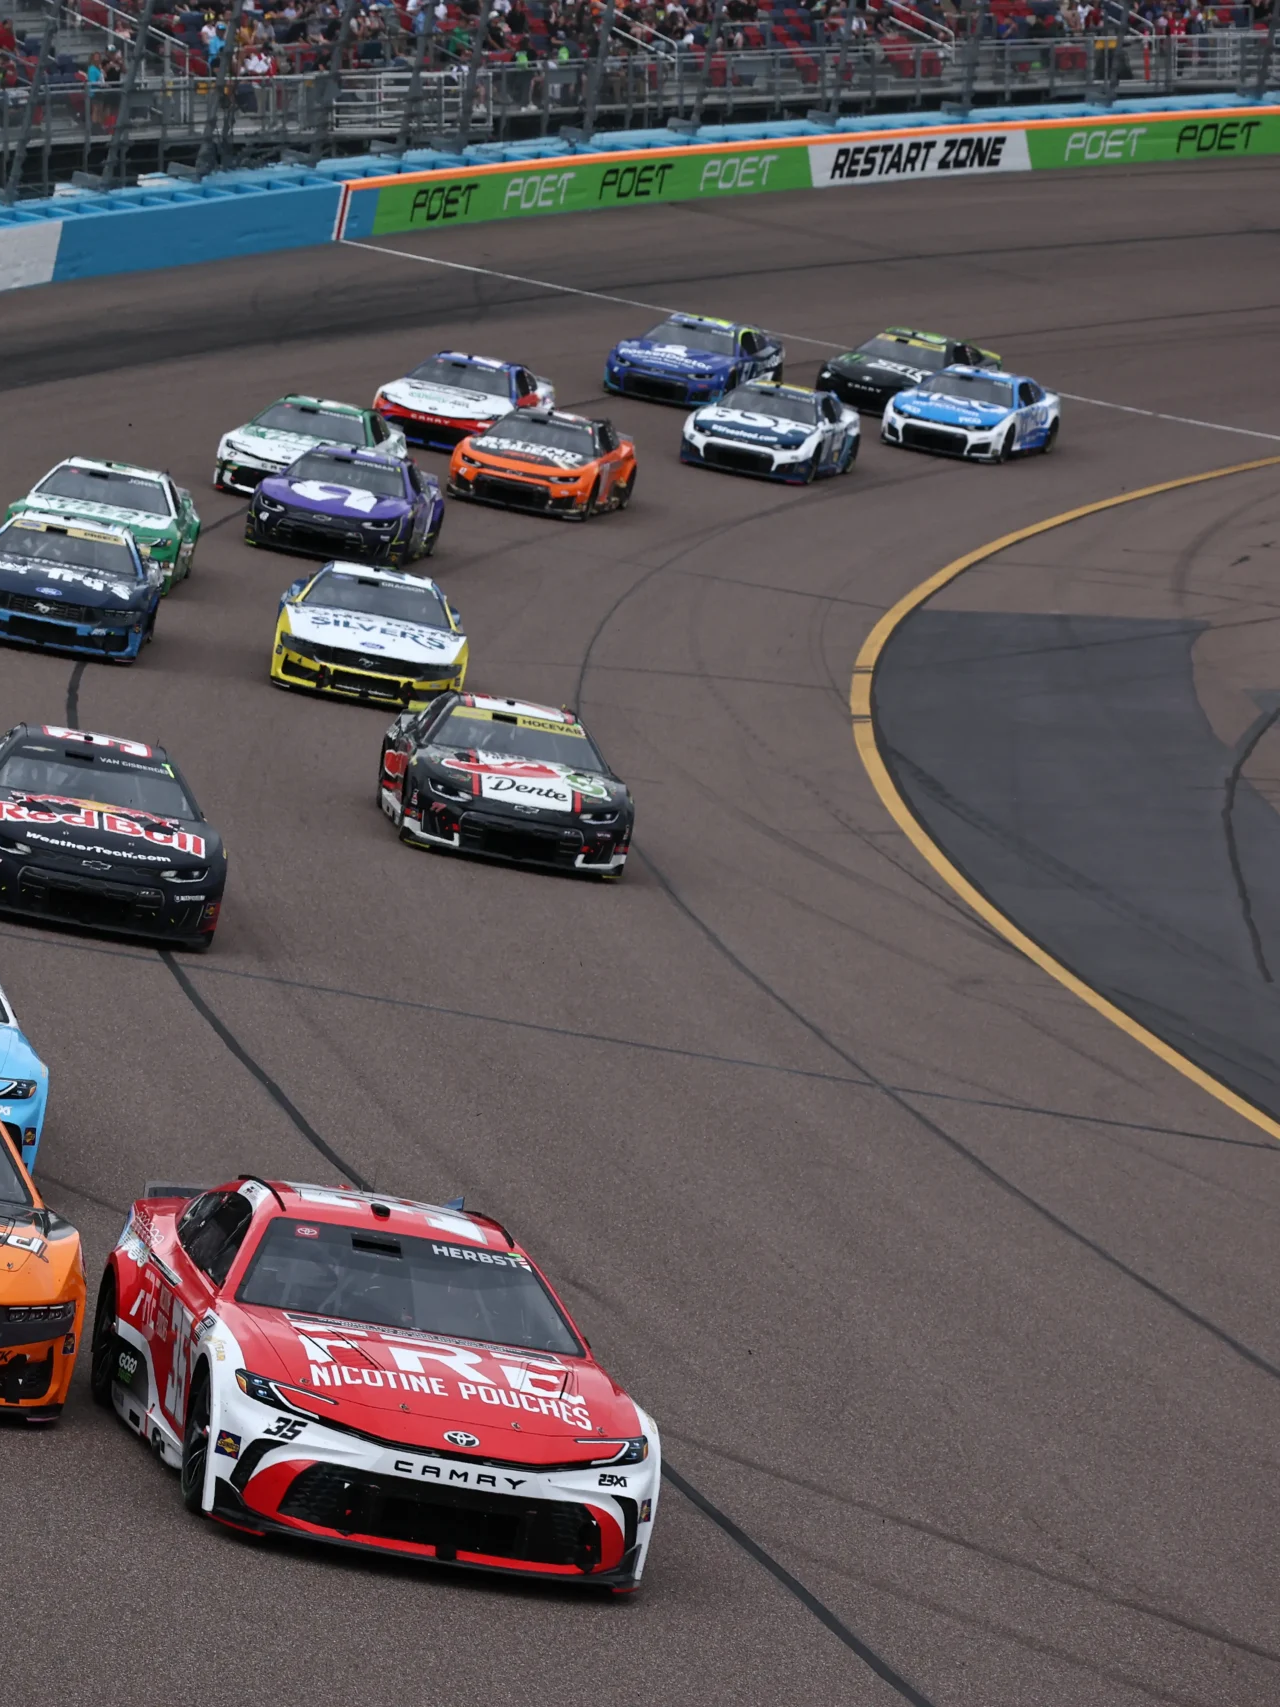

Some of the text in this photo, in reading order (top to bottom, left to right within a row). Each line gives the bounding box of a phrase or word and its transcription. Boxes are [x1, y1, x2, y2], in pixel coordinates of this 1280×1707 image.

[1065, 128, 1147, 161] POET
[1176, 121, 1261, 154] POET
[700, 154, 779, 191] POET
[830, 136, 1007, 180] RESTART ZONE
[503, 172, 576, 210] POET
[599, 163, 675, 200] POET
[410, 183, 480, 222] POET
[100, 757, 119, 765] VAN
[103, 812, 205, 859] Bull
[432, 1244, 520, 1269] HERBST
[291, 1321, 586, 1405] FRE
[309, 1364, 592, 1431] NICOTINE POUCHES
[262, 1416, 308, 1440] 35
[394, 1460, 527, 1490] CAMRY
